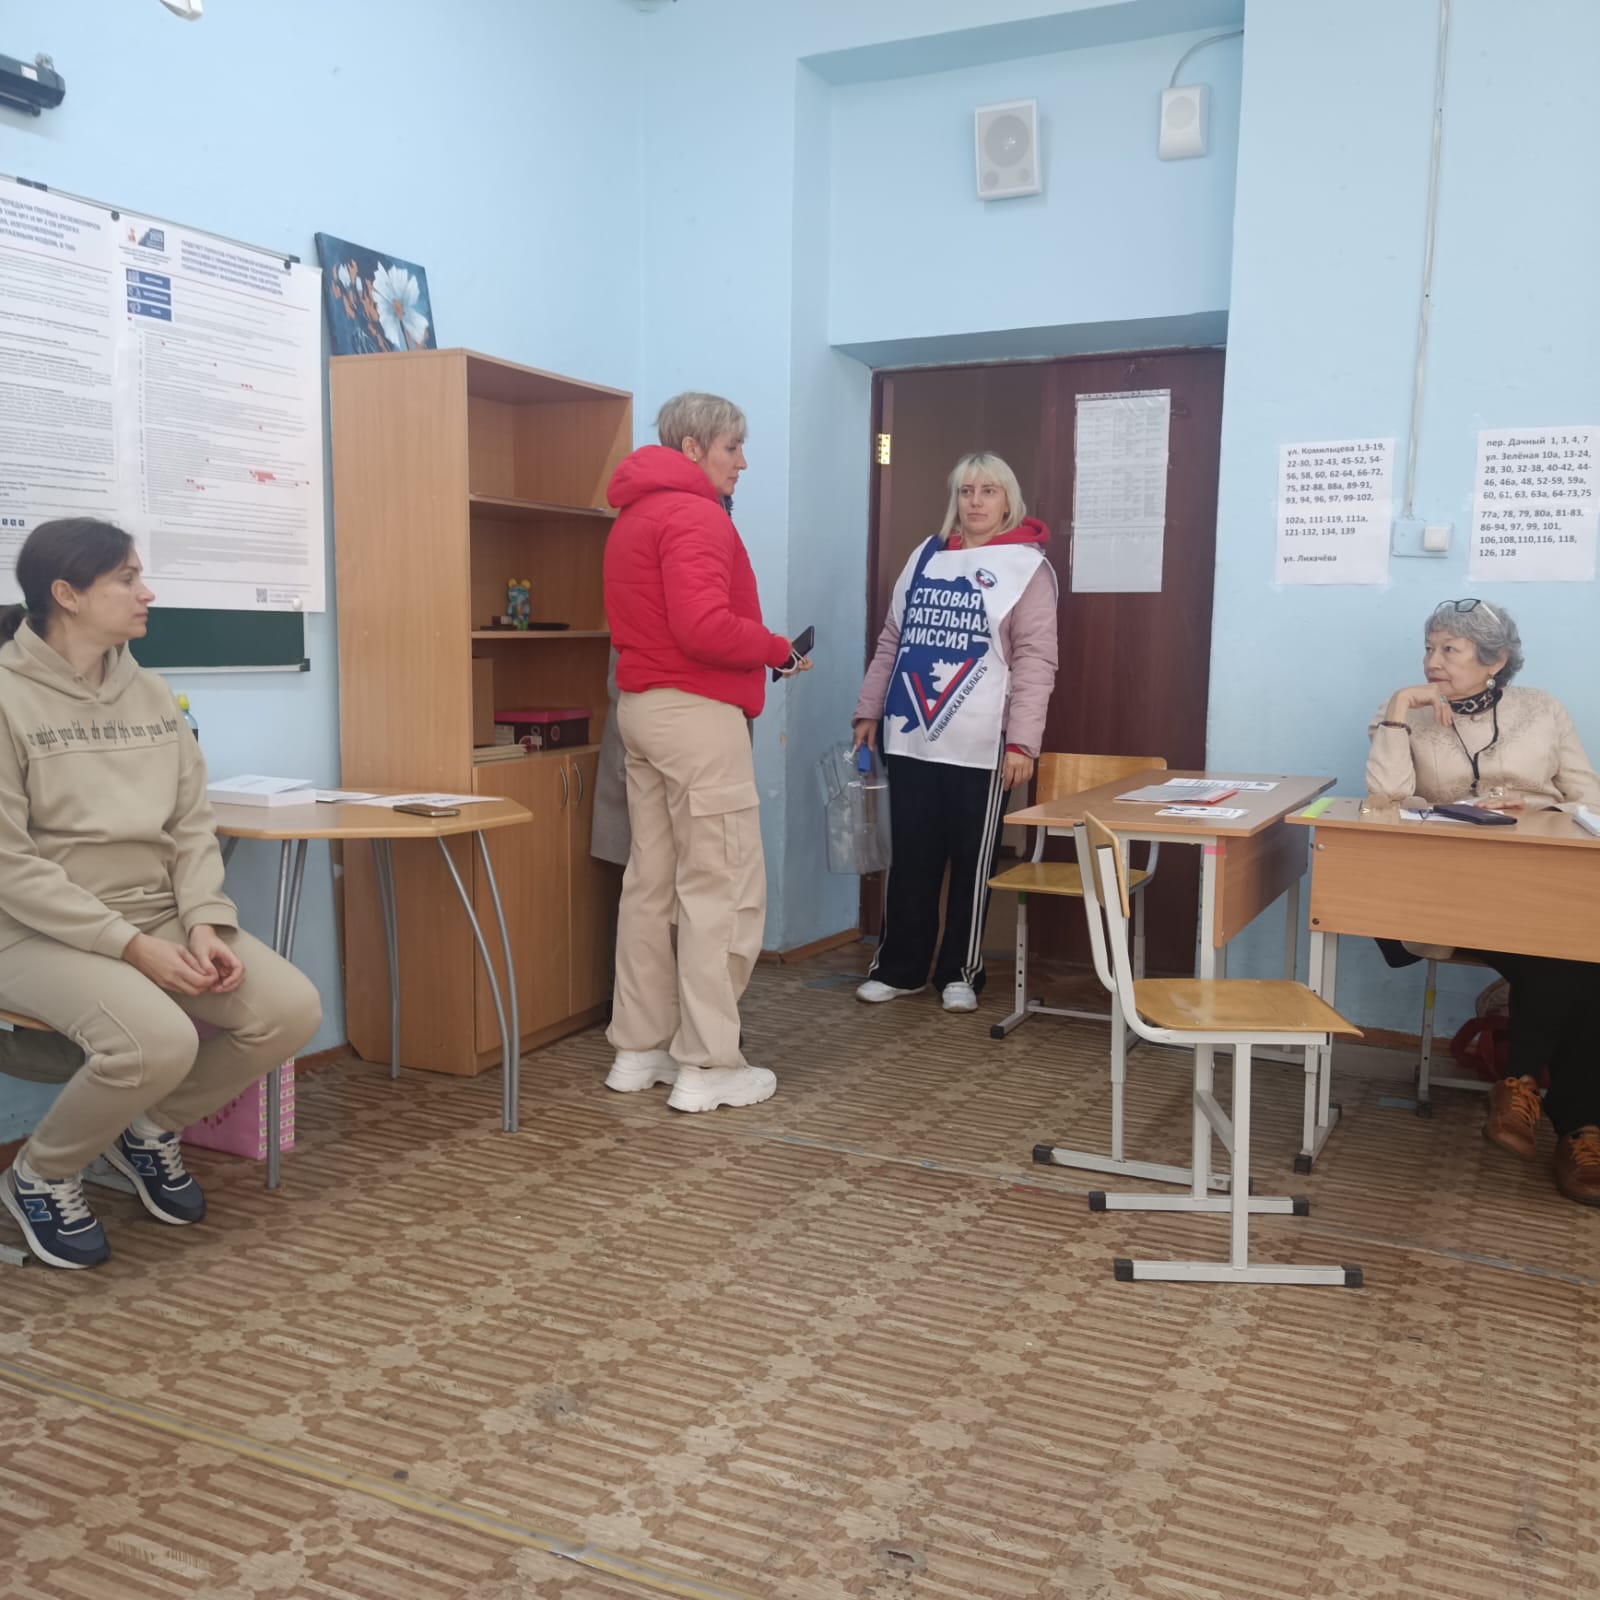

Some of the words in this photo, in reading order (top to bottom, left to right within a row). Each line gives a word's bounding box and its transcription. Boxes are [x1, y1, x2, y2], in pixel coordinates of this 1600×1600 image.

[1508, 437, 1546, 447] Дачный
[1551, 437, 1558, 445] 1,
[1571, 436, 1580, 444] 4,
[1302, 446, 1354, 455] Комильцева
[1501, 452, 1539, 460] Зелёная
[1564, 450, 1591, 458] 13-24,
[1314, 458, 1338, 466] 32-43,
[1357, 468, 1383, 476] 66-72,
[1485, 466, 1498, 474] 28,
[1516, 465, 1544, 473] 32-38,
[1546, 464, 1574, 472] 40-42,
[1347, 481, 1372, 489] 89-91,
[1537, 477, 1564, 485] 52-59,
[1329, 495, 1340, 503] 97,
[1344, 494, 1374, 502] 99-102,
[1483, 492, 1496, 500] 60,
[1518, 510, 1531, 518] 79,
[1555, 509, 1584, 517] 81-83,
[1510, 523, 1523, 531] 97,
[1543, 522, 1561, 530] 101,
[1285, 528, 1318, 536] 121-132,
[1480, 549, 1497, 557] 126,
[911, 588, 981, 610] СТКОВАЯ
[906, 607, 991, 634] РАТЕЛЬНАЯ
[901, 626, 969, 651] МИССИЯ
[928, 694, 966, 742] ЧЕЛЯБИНСКАЯ
[963, 665, 988, 696] ОБЛАСТЬ
[23, 1198, 52, 1222] N
